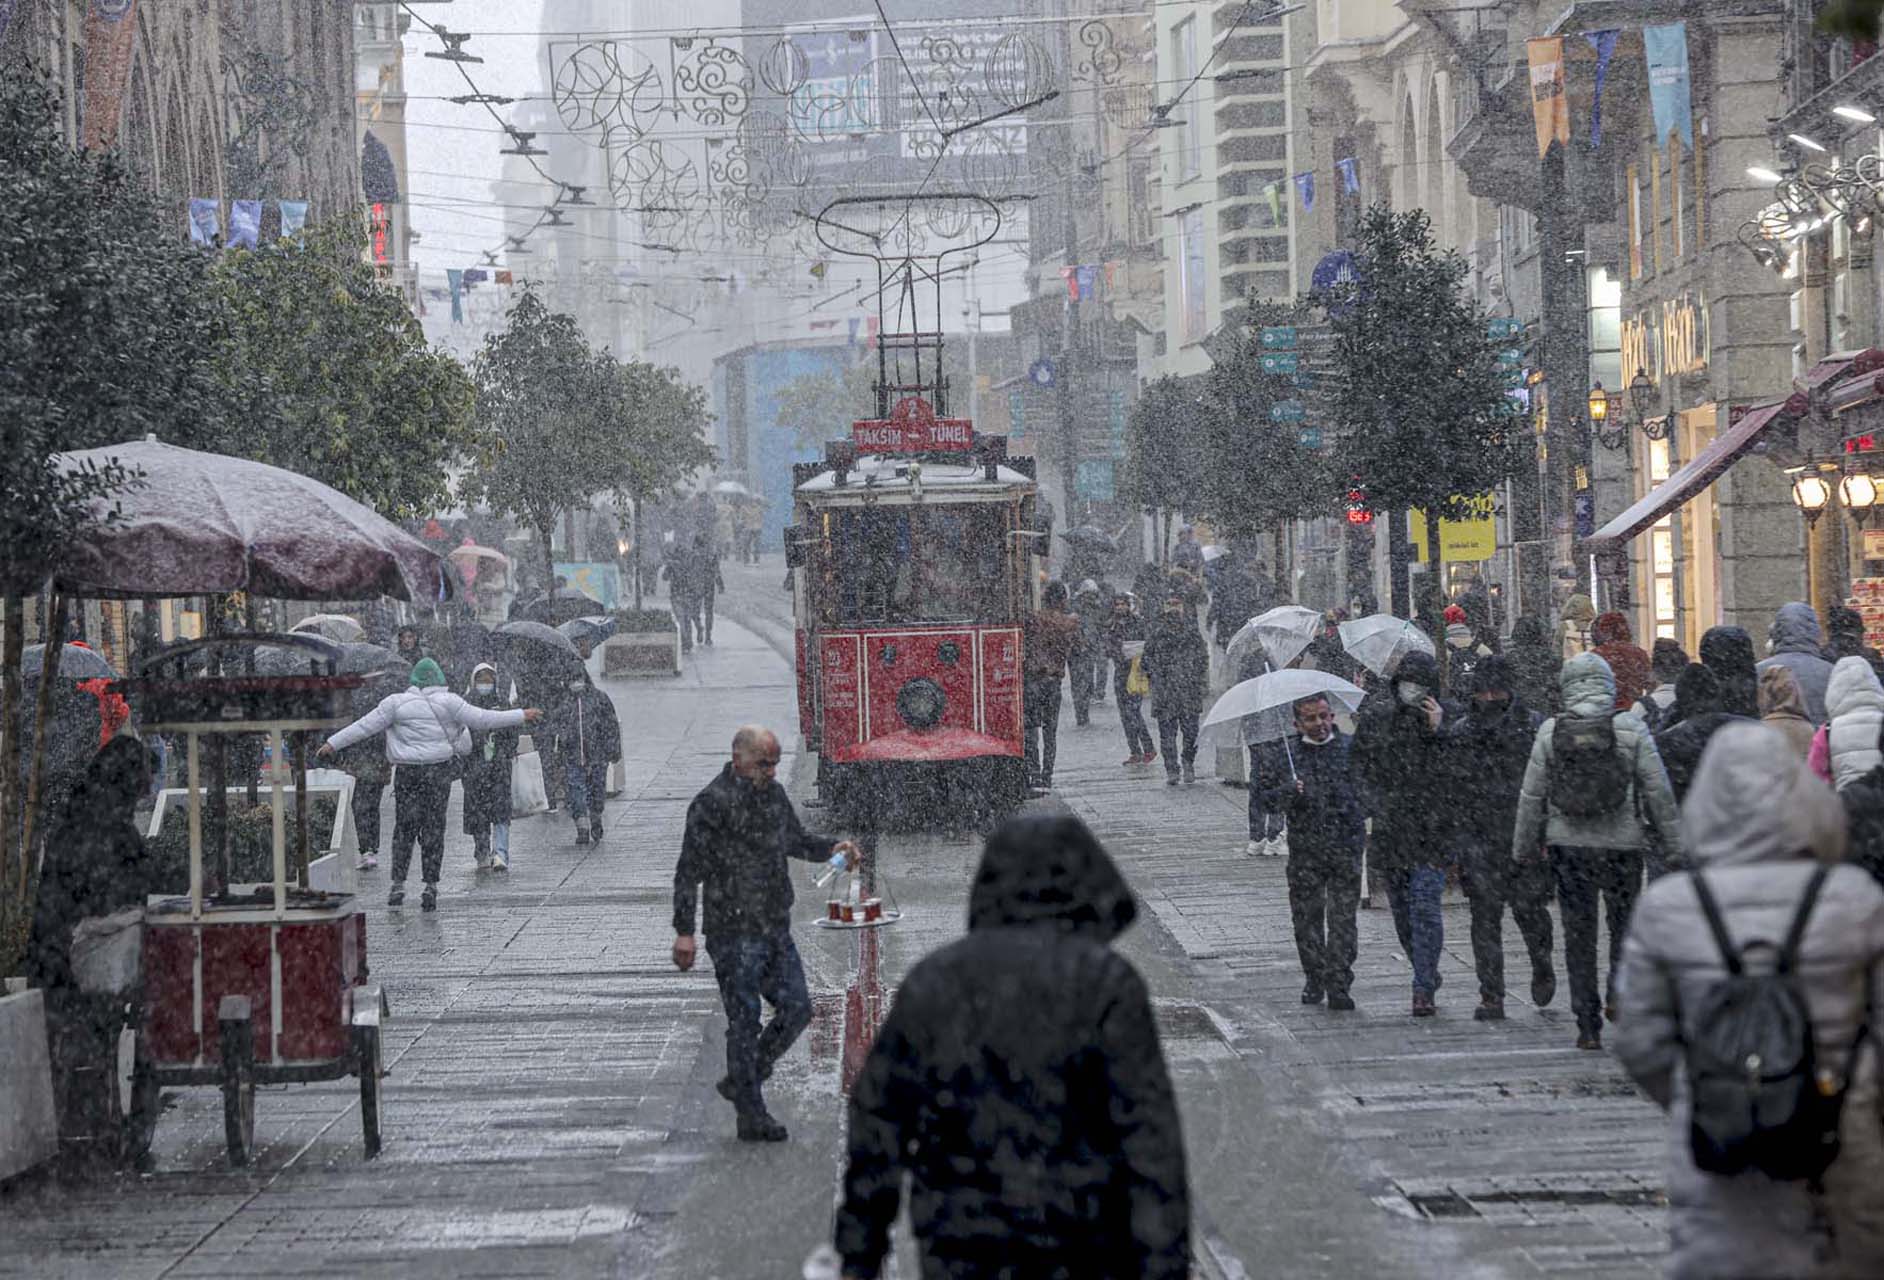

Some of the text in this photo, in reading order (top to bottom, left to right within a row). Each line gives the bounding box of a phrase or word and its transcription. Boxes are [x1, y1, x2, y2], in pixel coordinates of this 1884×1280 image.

[908, 400, 917, 418] 2
[857, 424, 901, 445] TAKSİM
[930, 422, 969, 442] TÜNEL
